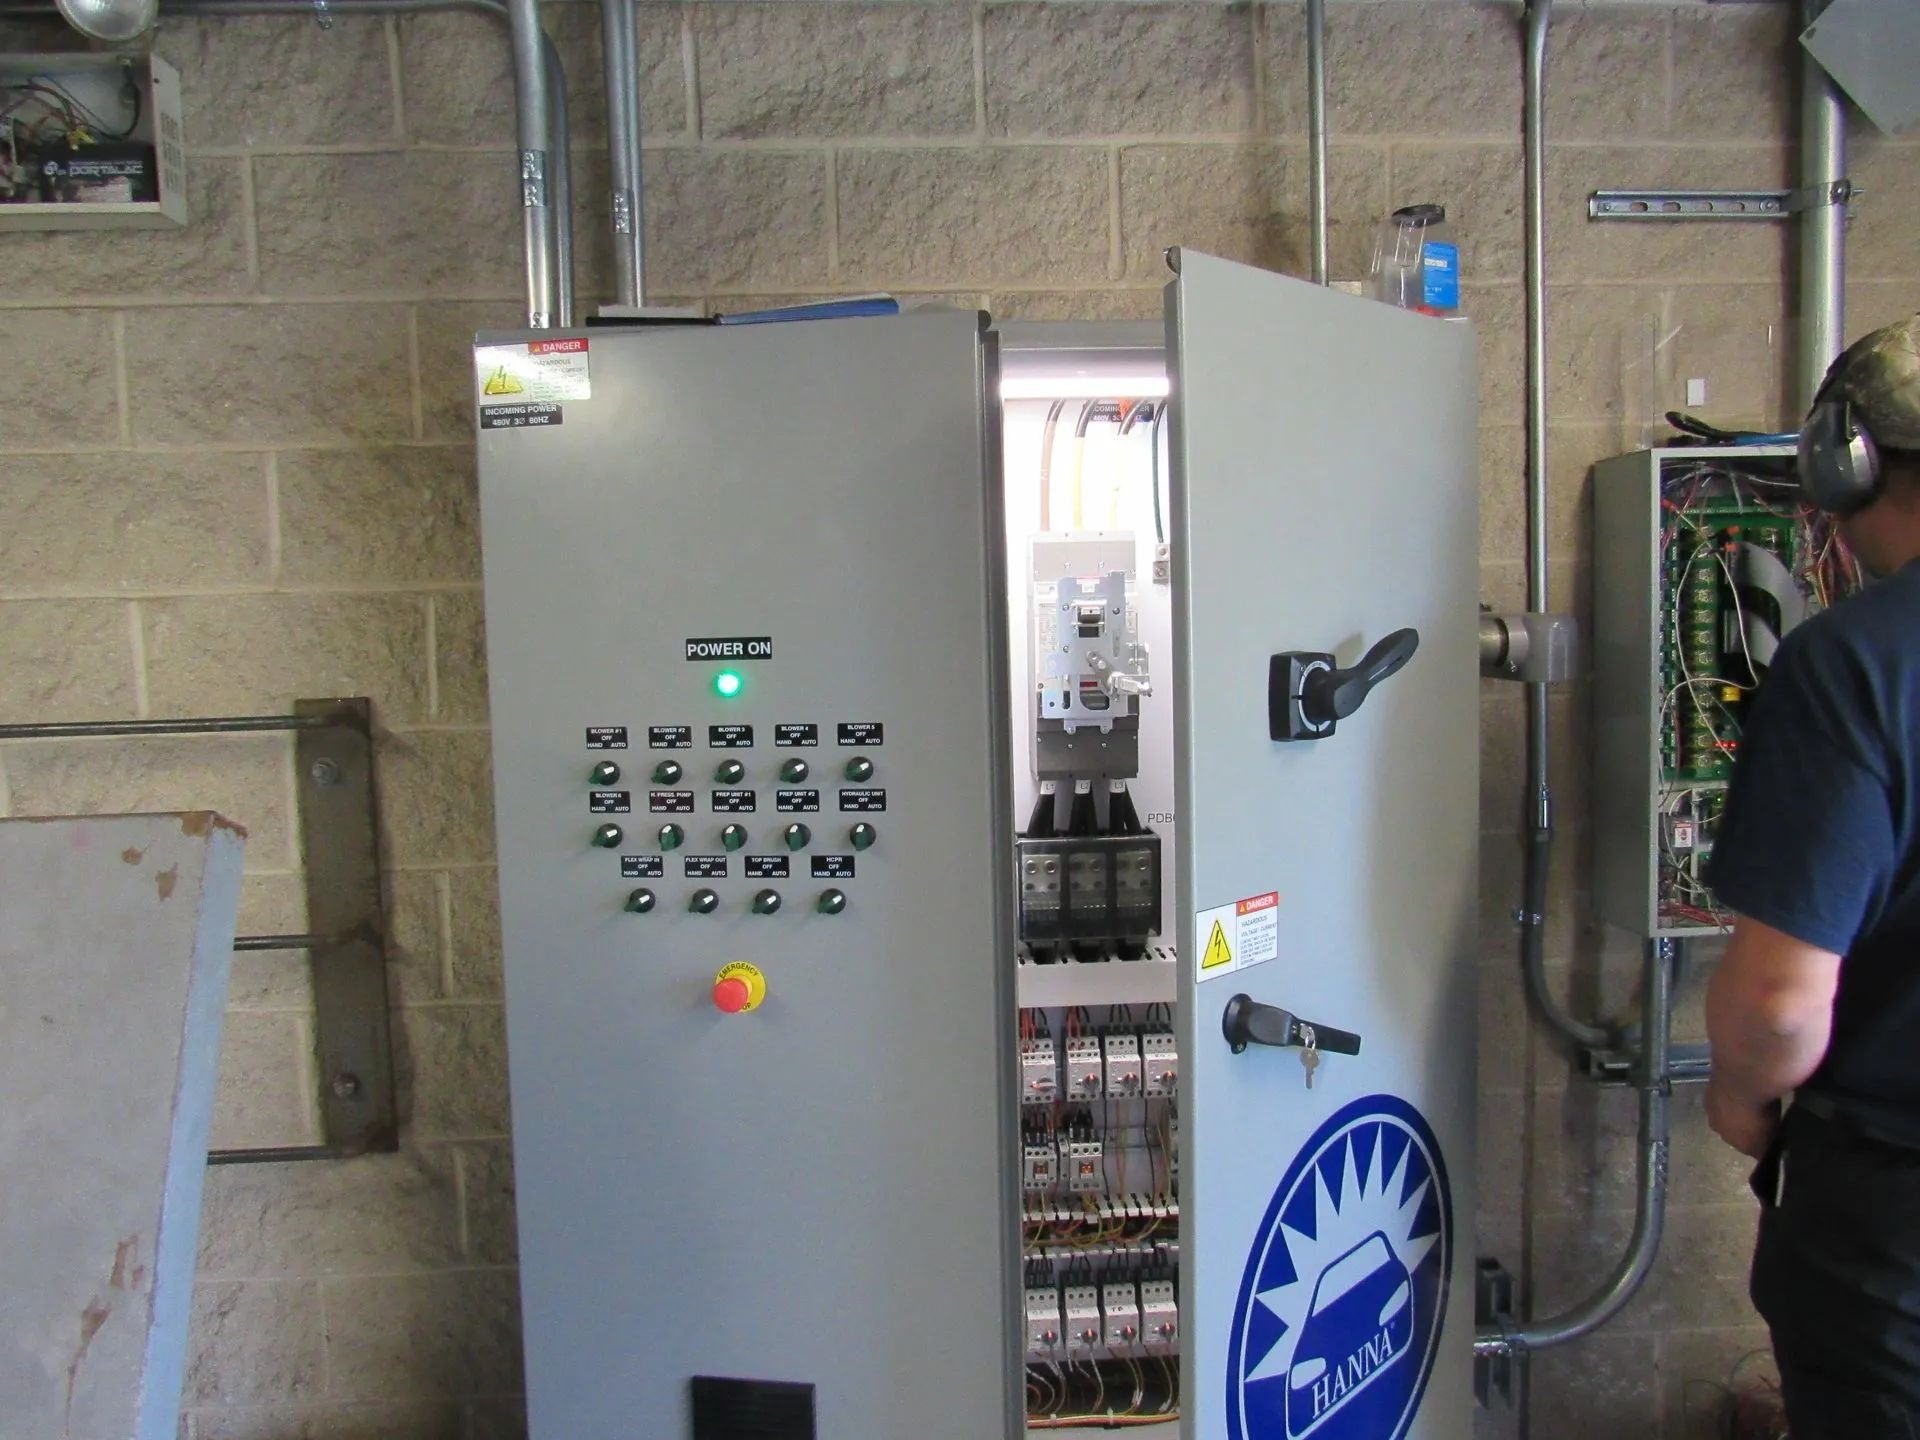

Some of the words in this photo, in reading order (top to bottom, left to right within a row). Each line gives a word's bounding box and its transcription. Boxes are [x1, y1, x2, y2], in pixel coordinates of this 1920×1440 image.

[543, 342, 581, 352] DANGER
[485, 406, 526, 416] INCOMING
[528, 405, 557, 413] POWER
[492, 418, 510, 426] 480V
[687, 642, 744, 656] POWER
[747, 641, 771, 655] ON
[1246, 895, 1273, 911] DANGER
[719, 963, 759, 978] EMERGENCY
[1312, 1327, 1393, 1419] HANNA
